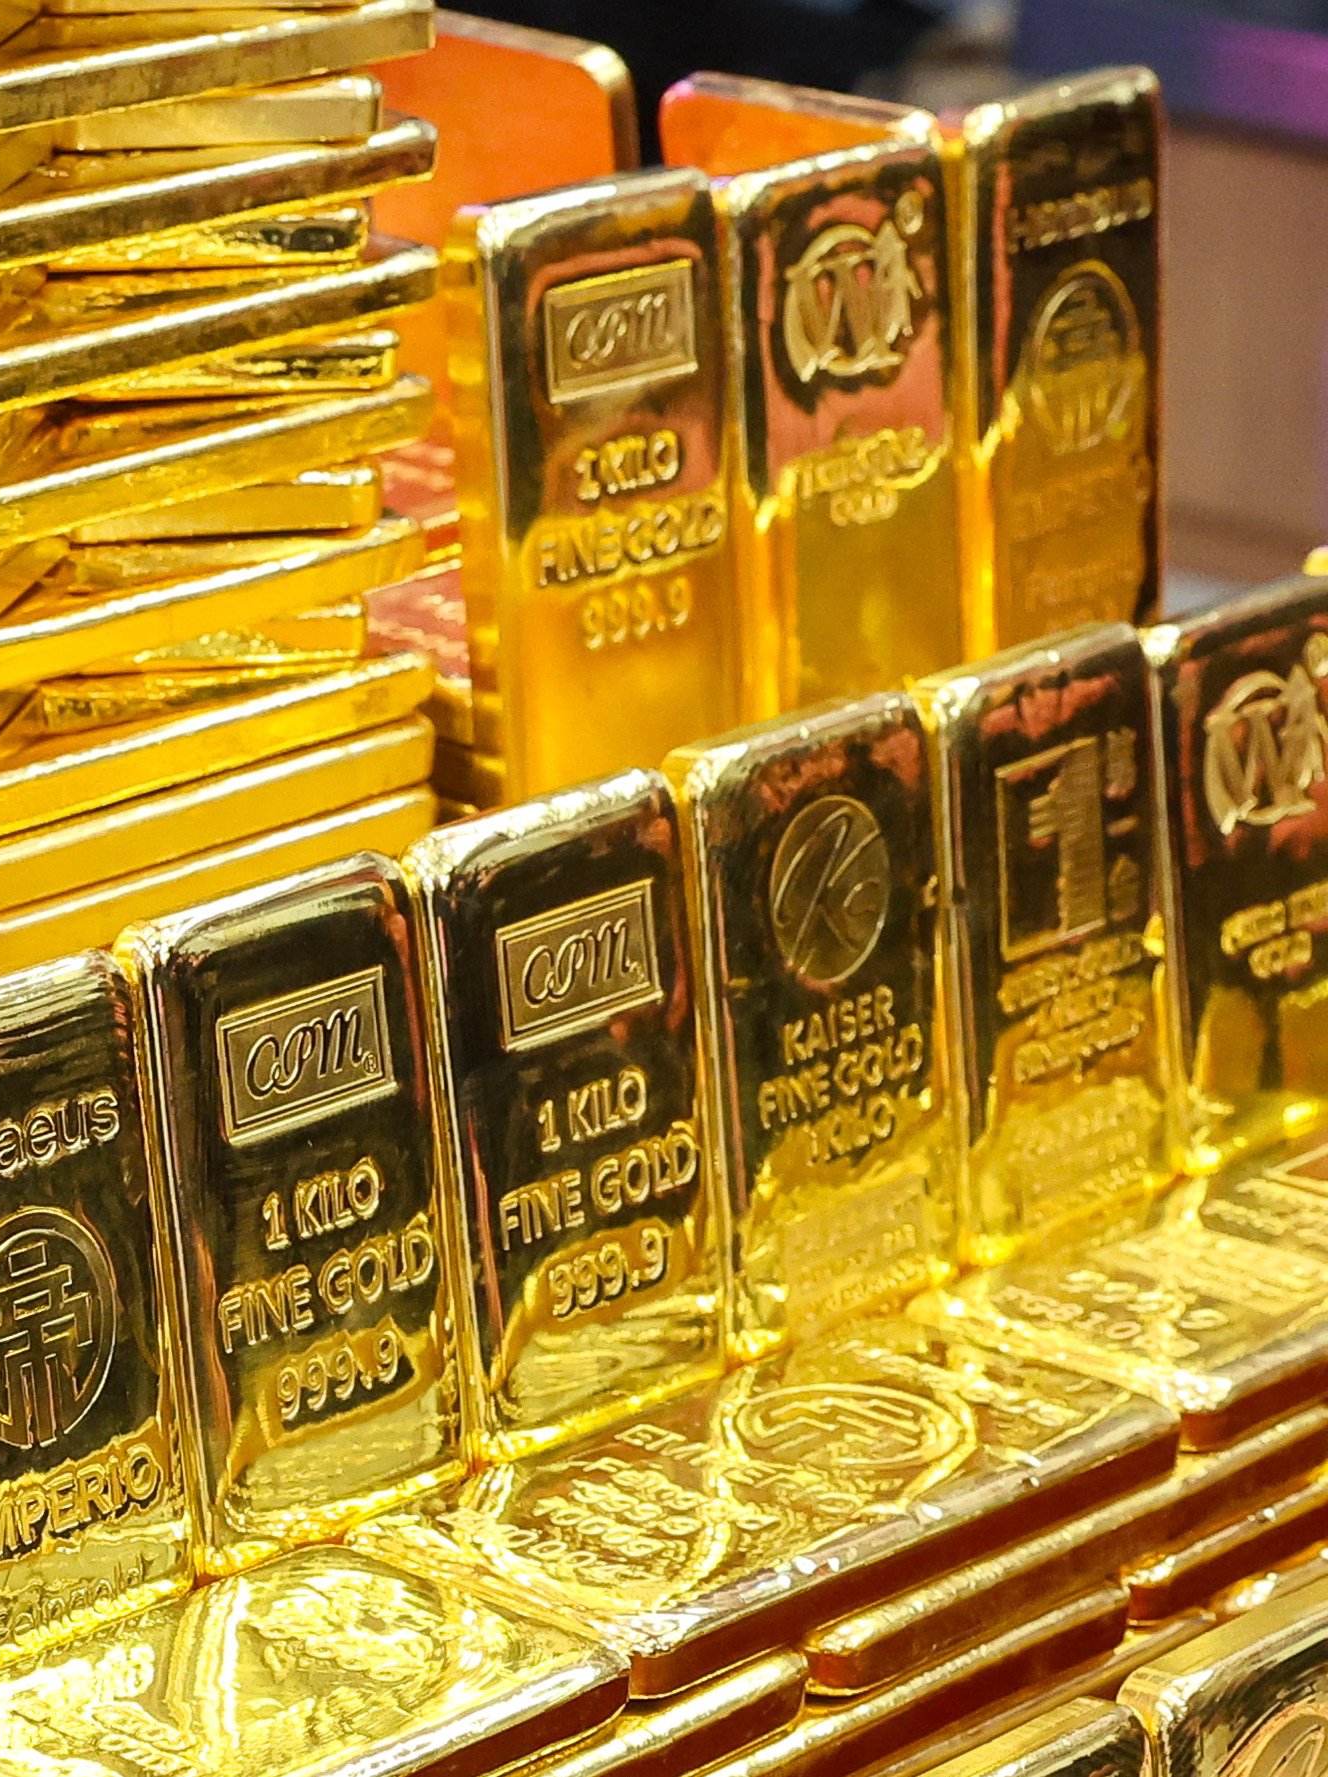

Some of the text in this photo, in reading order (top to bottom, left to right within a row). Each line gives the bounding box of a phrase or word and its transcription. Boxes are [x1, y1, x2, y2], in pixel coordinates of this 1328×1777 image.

[575, 428, 680, 500] 1 KILO
[536, 498, 724, 587] FINE GOLD
[582, 576, 691, 653] 999.9
[783, 985, 896, 1065] KAISER
[537, 1064, 647, 1154] 1 KILO
[759, 1022, 924, 1130] FINE GOLD
[262, 1155, 383, 1252] 1 KILO
[498, 1124, 698, 1252] FINE GOLD
[218, 1222, 435, 1355] FINE GOLD
[549, 1222, 669, 1318] 999.9
[277, 1326, 402, 1422] 999.9
